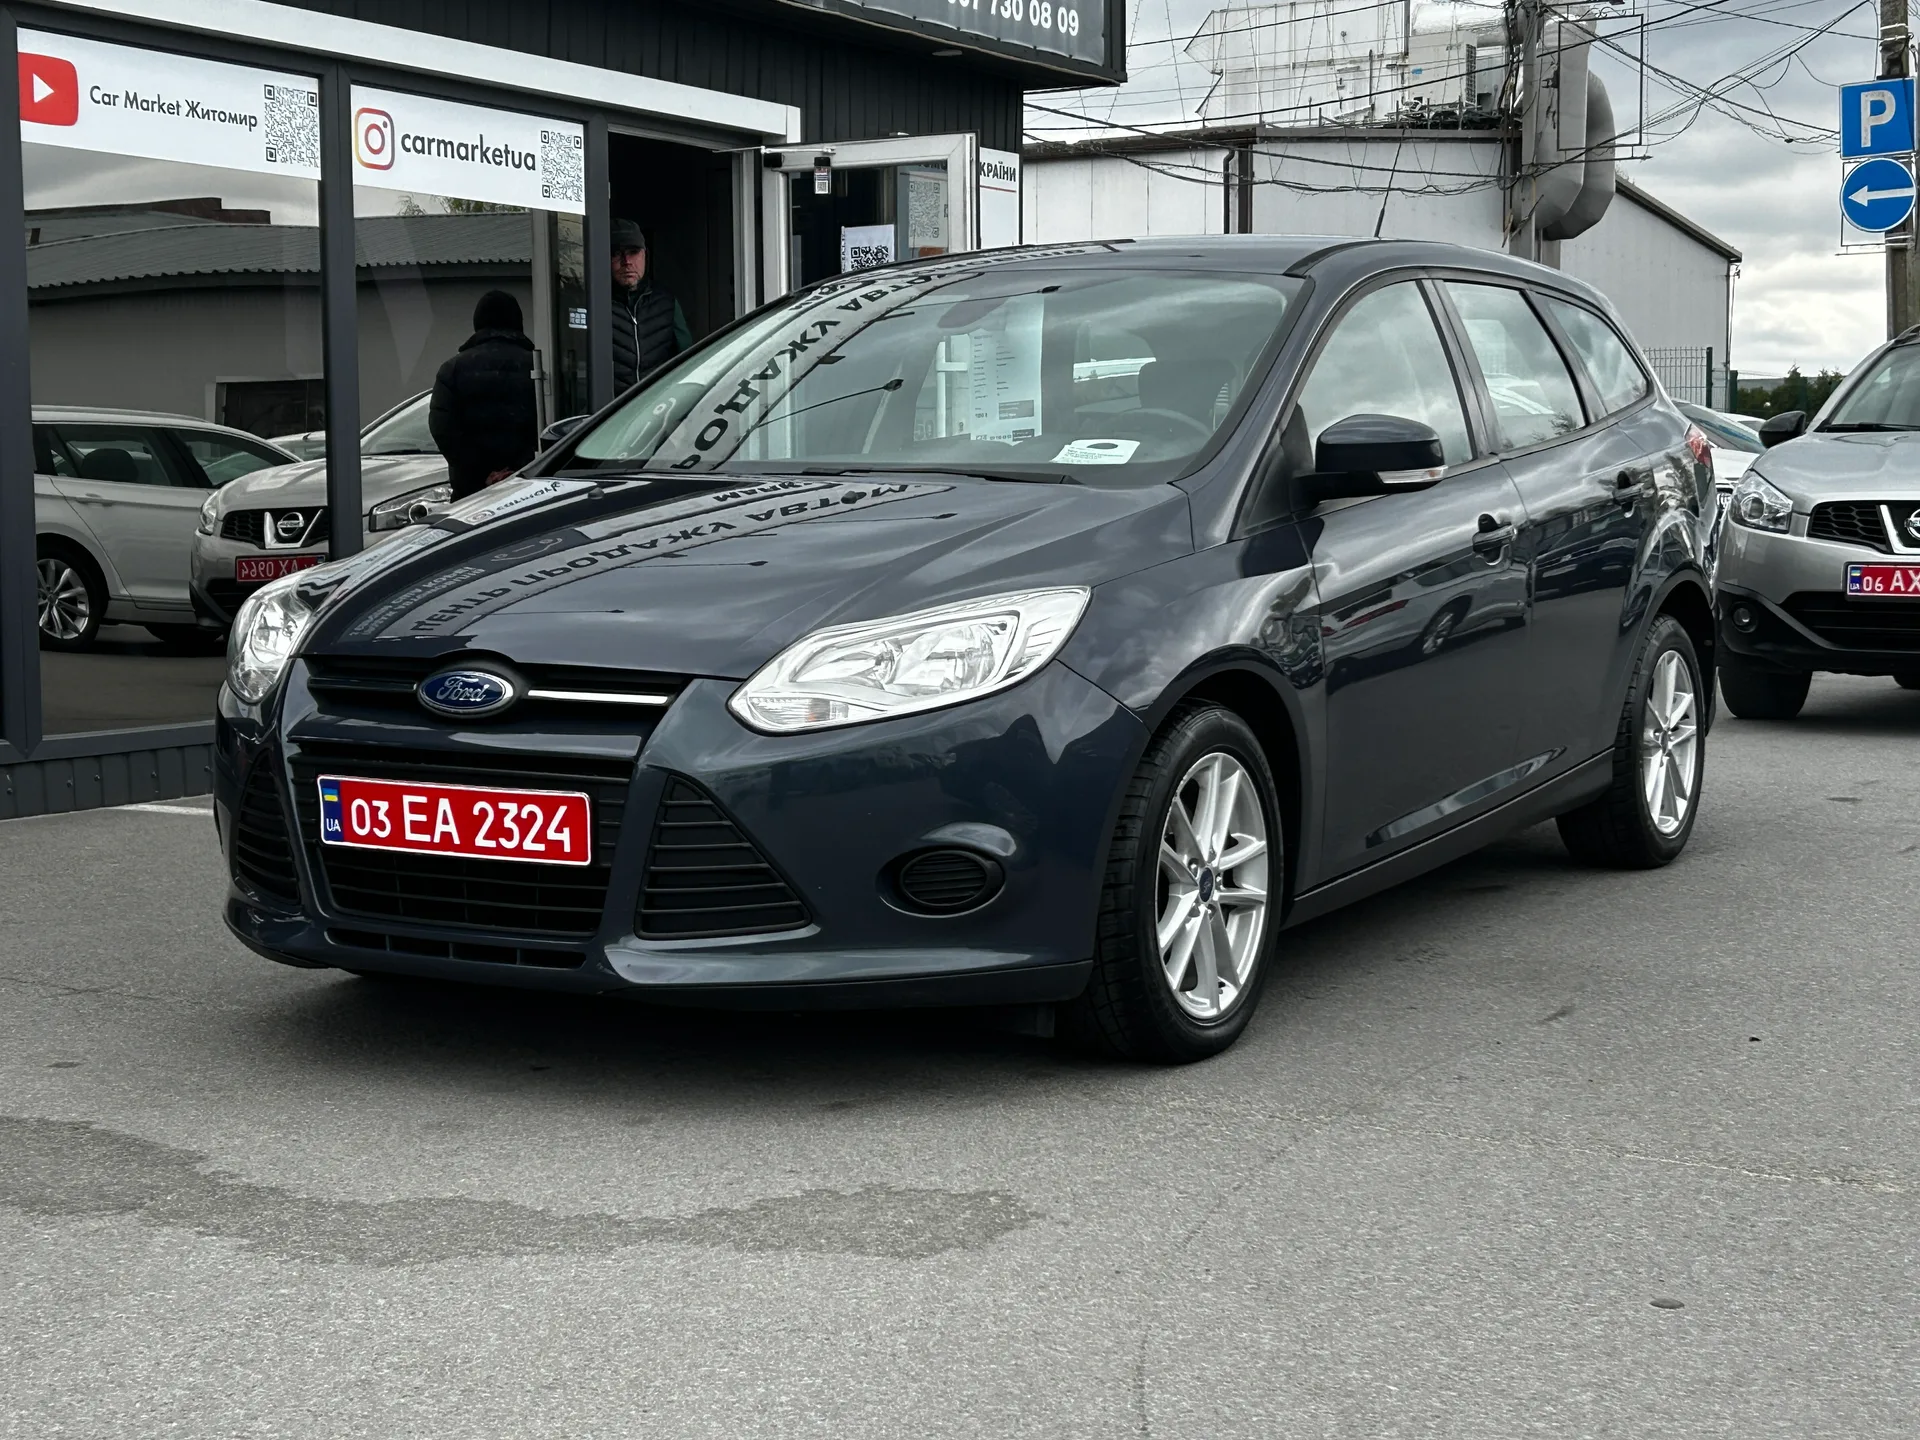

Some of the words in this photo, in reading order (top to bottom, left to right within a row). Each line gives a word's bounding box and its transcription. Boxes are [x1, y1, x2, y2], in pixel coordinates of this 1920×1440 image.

[1028, 0, 1052, 29] 08
[1056, 6, 1079, 37] 09
[89, 85, 119, 107] Car
[124, 90, 182, 117] Market
[184, 99, 258, 132] Житомир
[1860, 89, 1897, 148] P
[400, 133, 536, 171] carmarketua
[1862, 575, 1884, 592] 06
[1889, 569, 1920, 592] AX
[436, 676, 490, 702] Ford
[326, 818, 341, 832] UA
[350, 798, 392, 838] 03
[402, 794, 461, 845] EA
[472, 800, 572, 853] 2324
